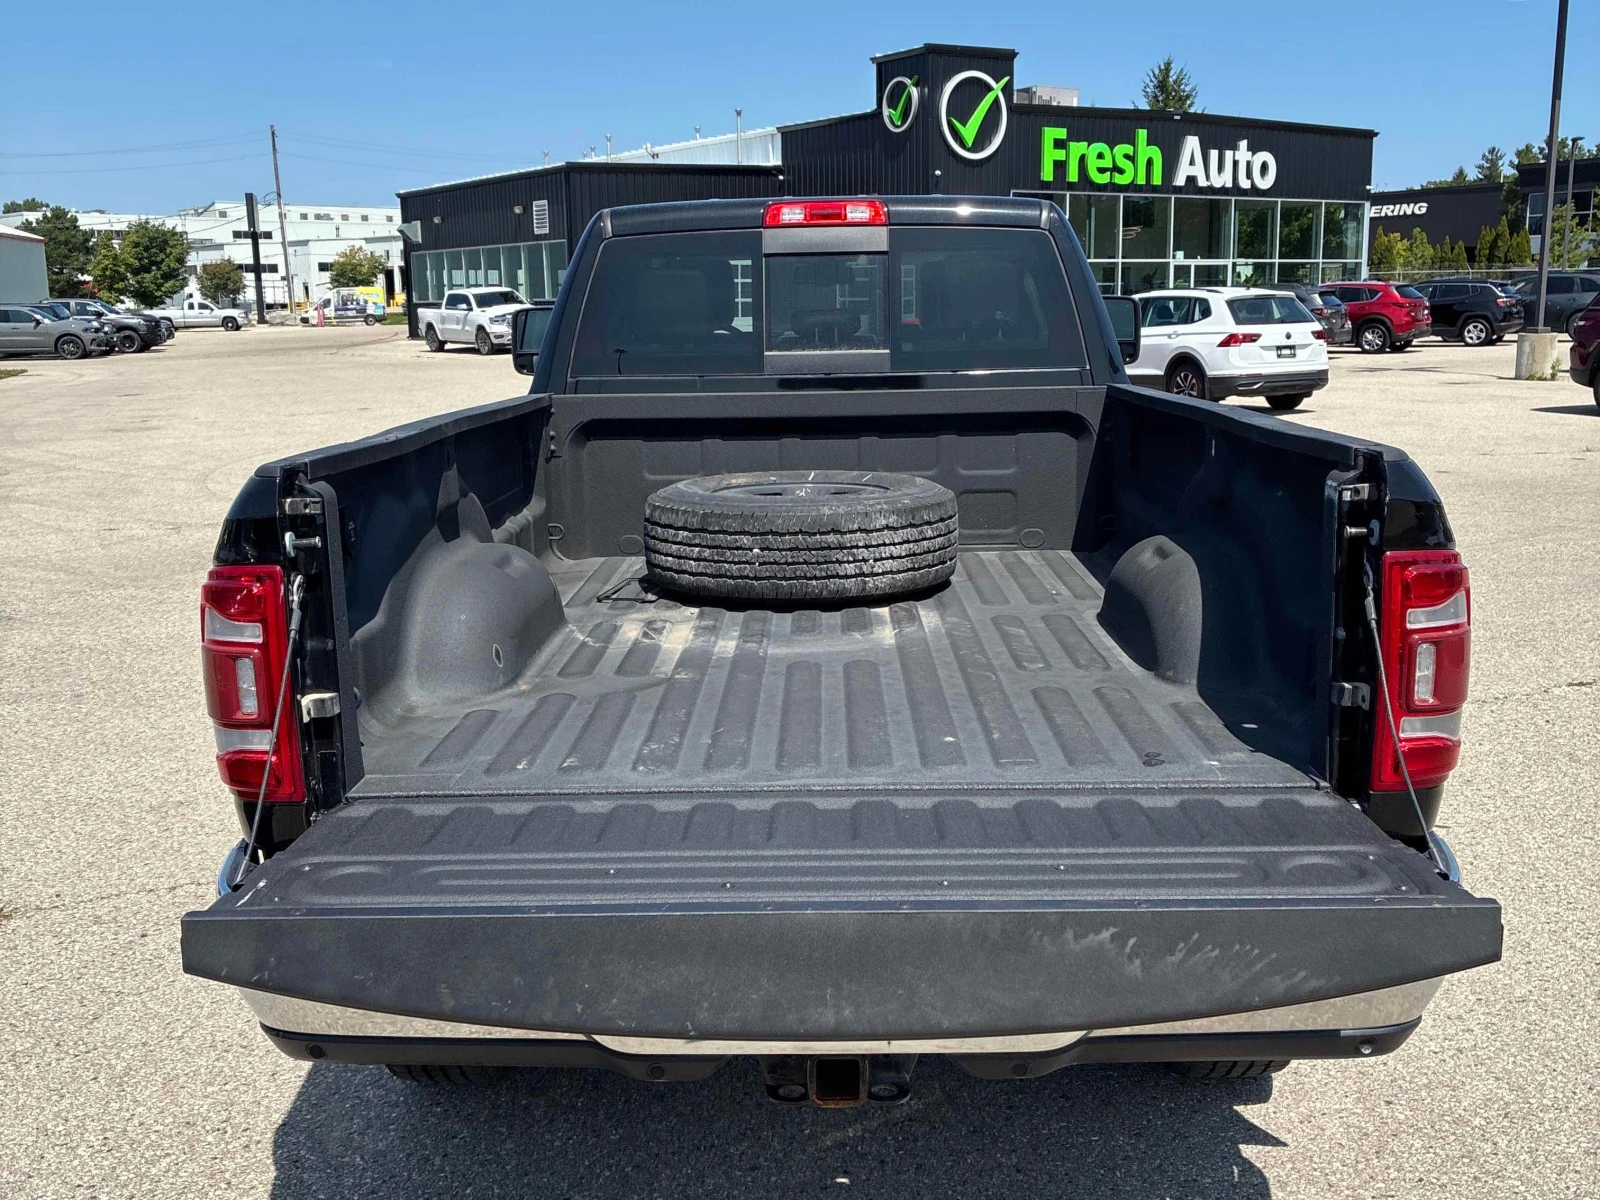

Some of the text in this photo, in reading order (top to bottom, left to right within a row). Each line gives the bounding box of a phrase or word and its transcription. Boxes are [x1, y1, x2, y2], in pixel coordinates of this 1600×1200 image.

[1041, 127, 1277, 190] Fresh Auto
[1370, 202, 1428, 217] ERING
